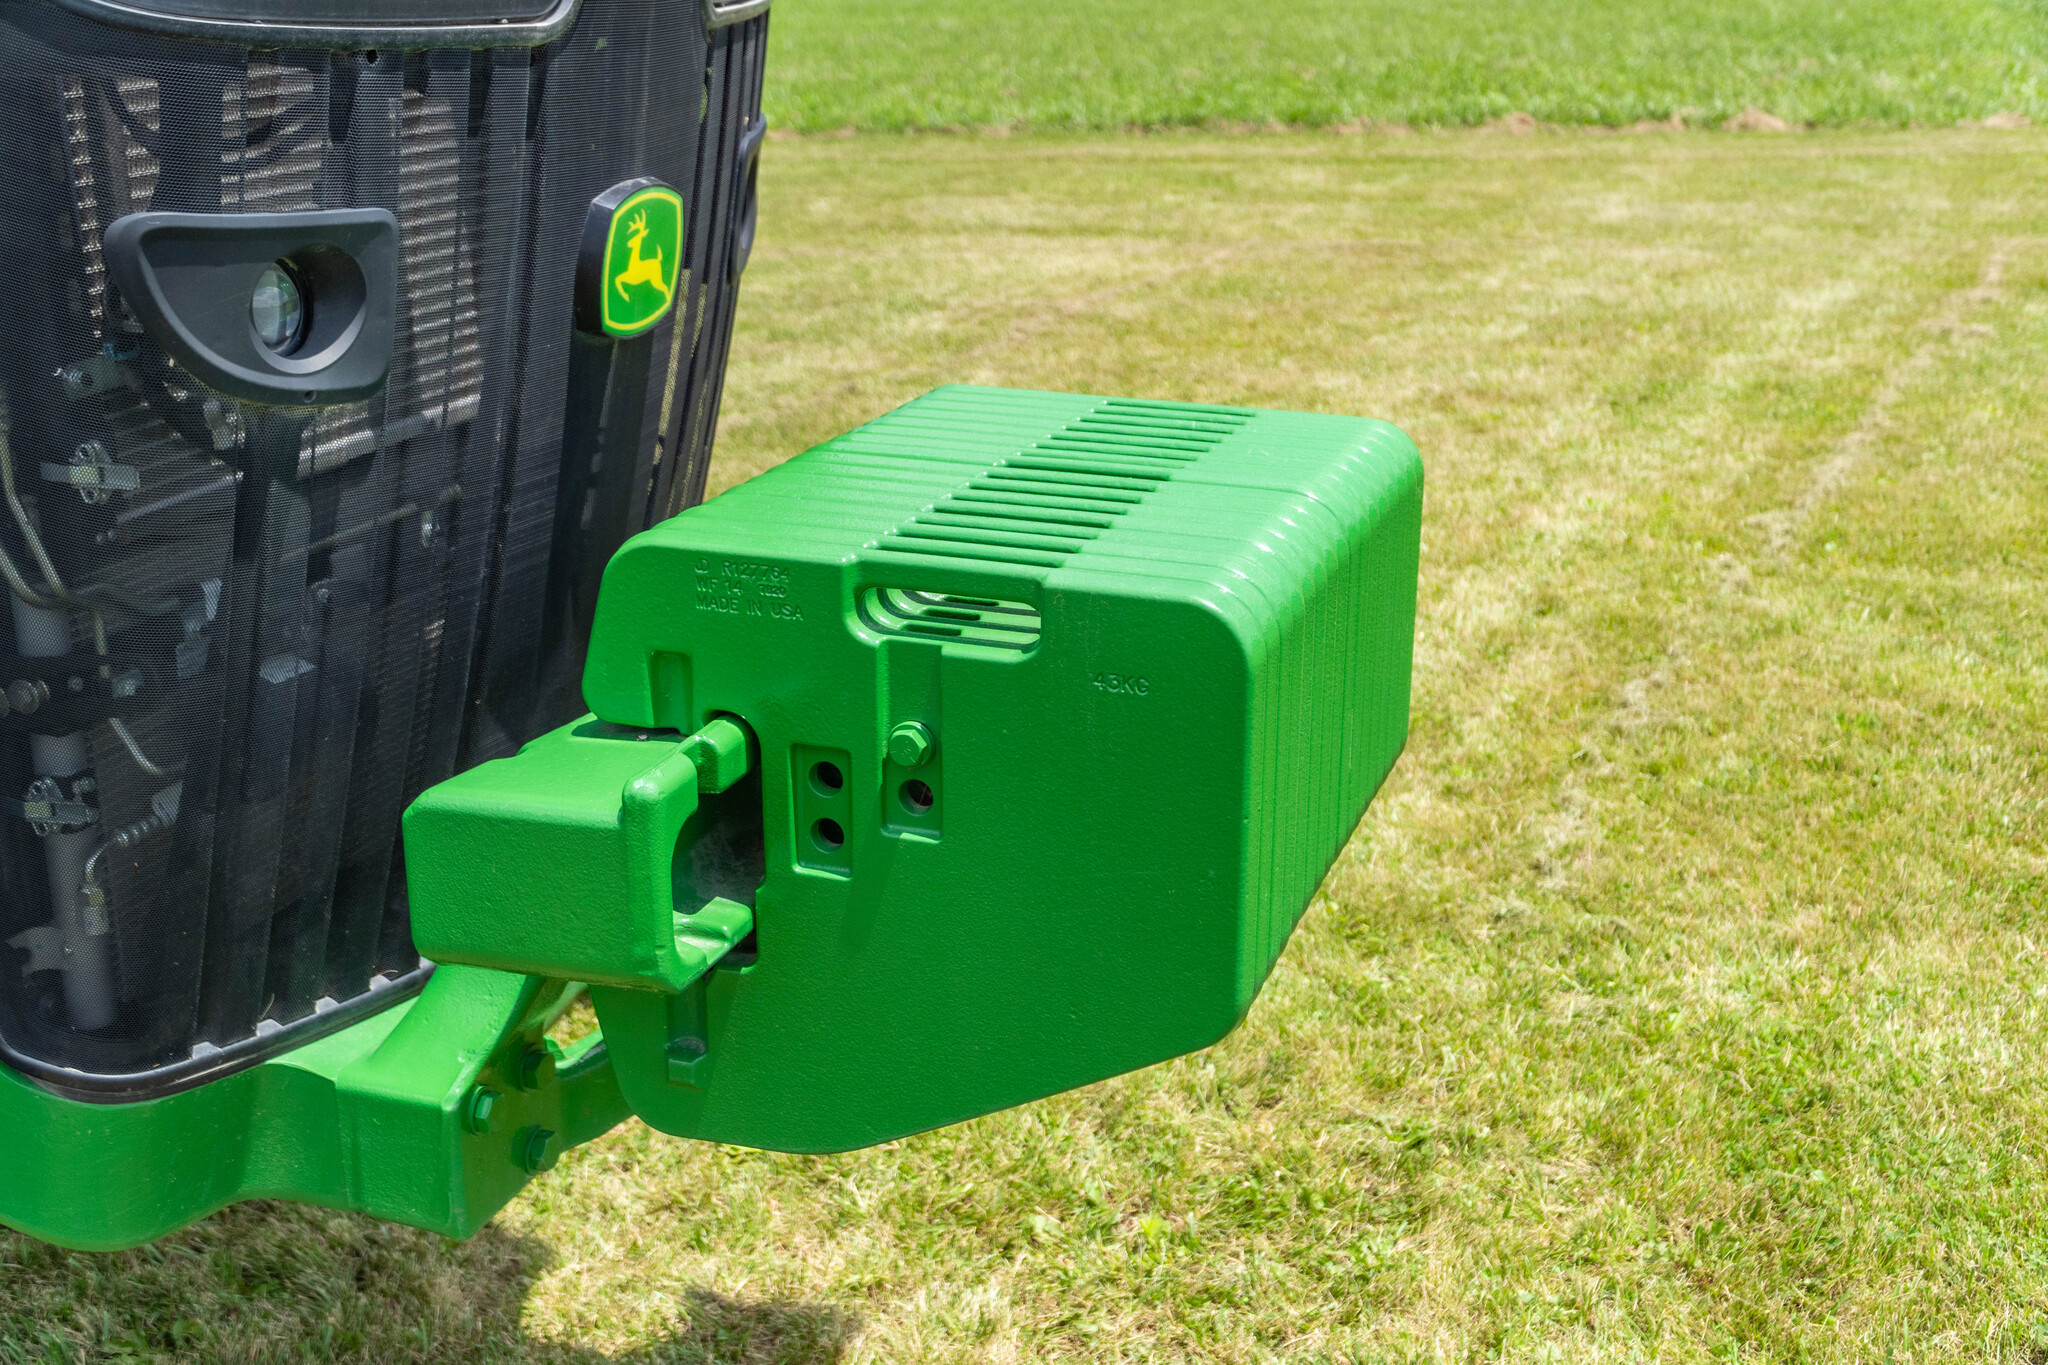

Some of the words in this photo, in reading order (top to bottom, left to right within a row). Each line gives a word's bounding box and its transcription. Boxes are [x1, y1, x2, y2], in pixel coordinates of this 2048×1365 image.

[725, 579, 743, 596] 14
[695, 594, 739, 614] MADE
[746, 599, 762, 617] IN
[770, 603, 804, 622] USA
[1093, 672, 1149, 696] 43KG
